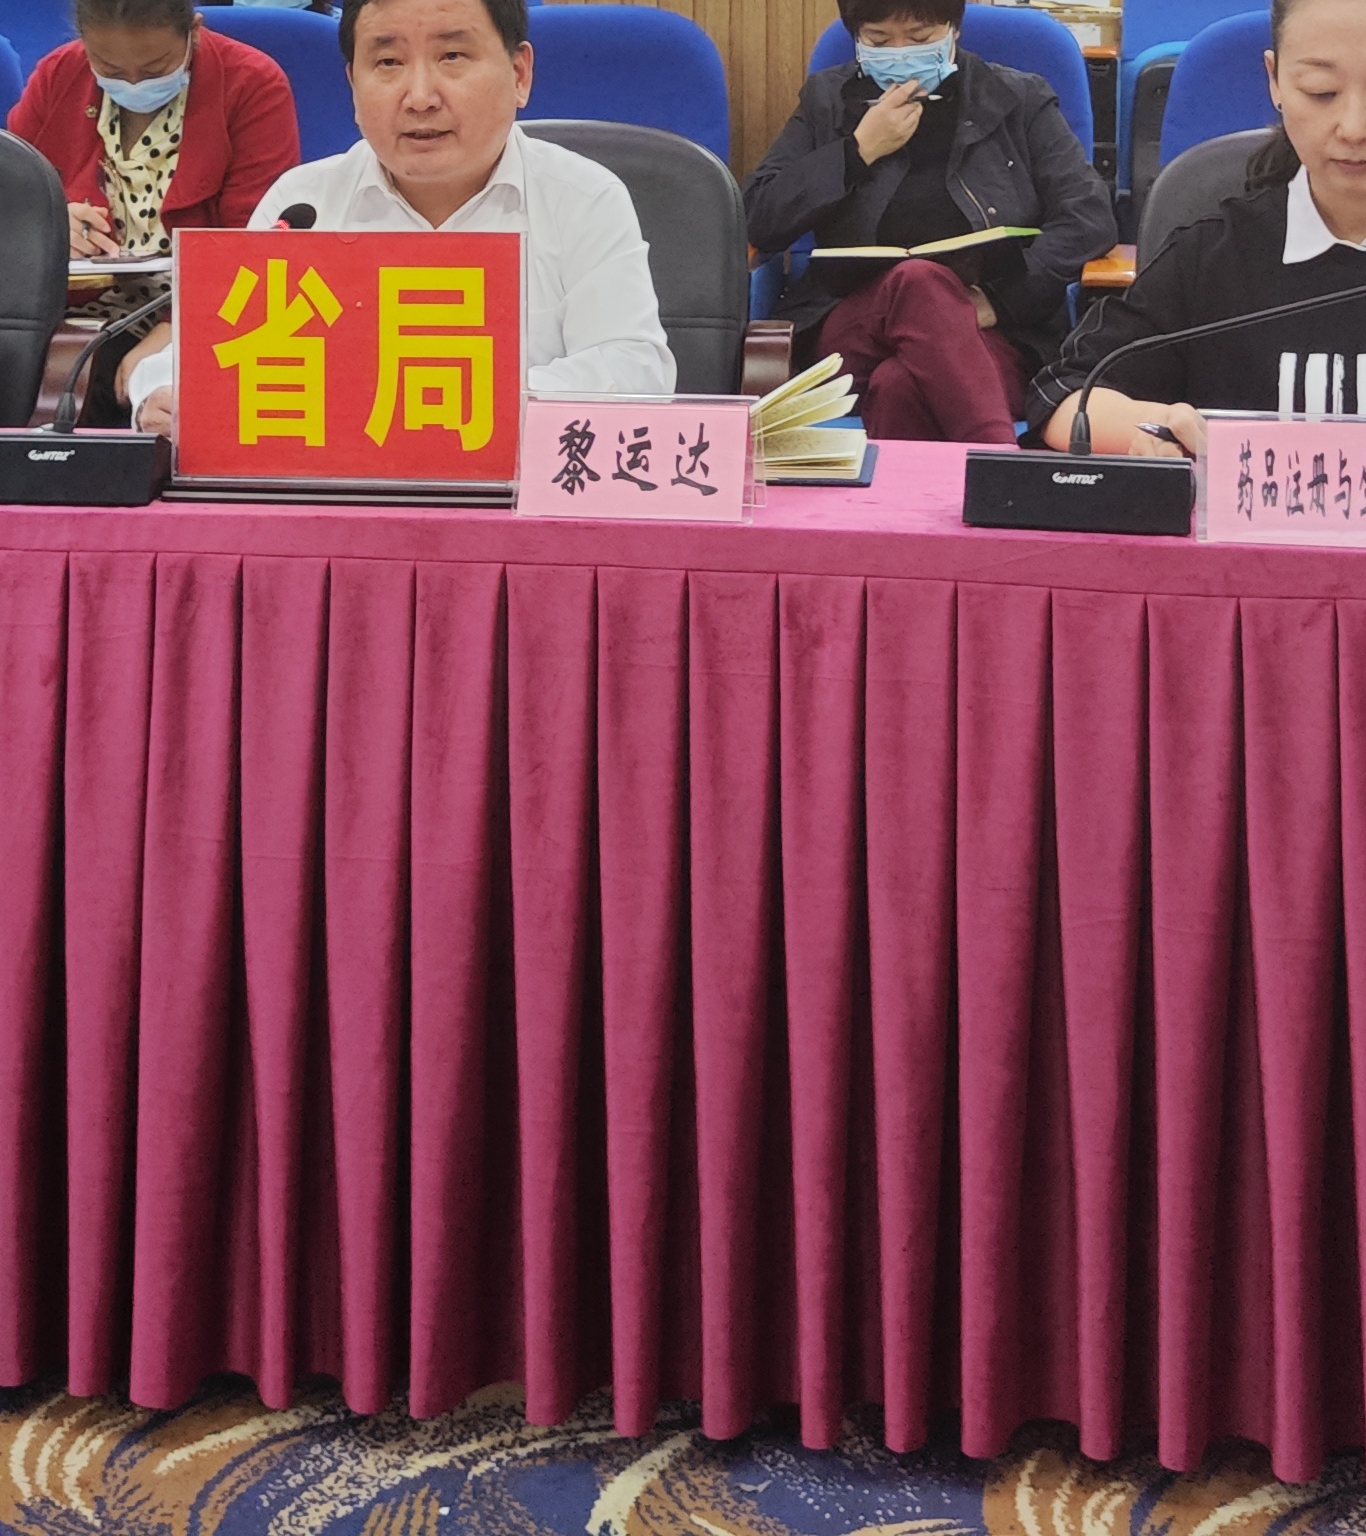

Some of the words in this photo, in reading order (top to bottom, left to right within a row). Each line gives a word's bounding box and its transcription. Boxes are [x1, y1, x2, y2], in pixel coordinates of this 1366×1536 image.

[212, 258, 494, 451] 省局
[552, 419, 719, 496] 黎运达
